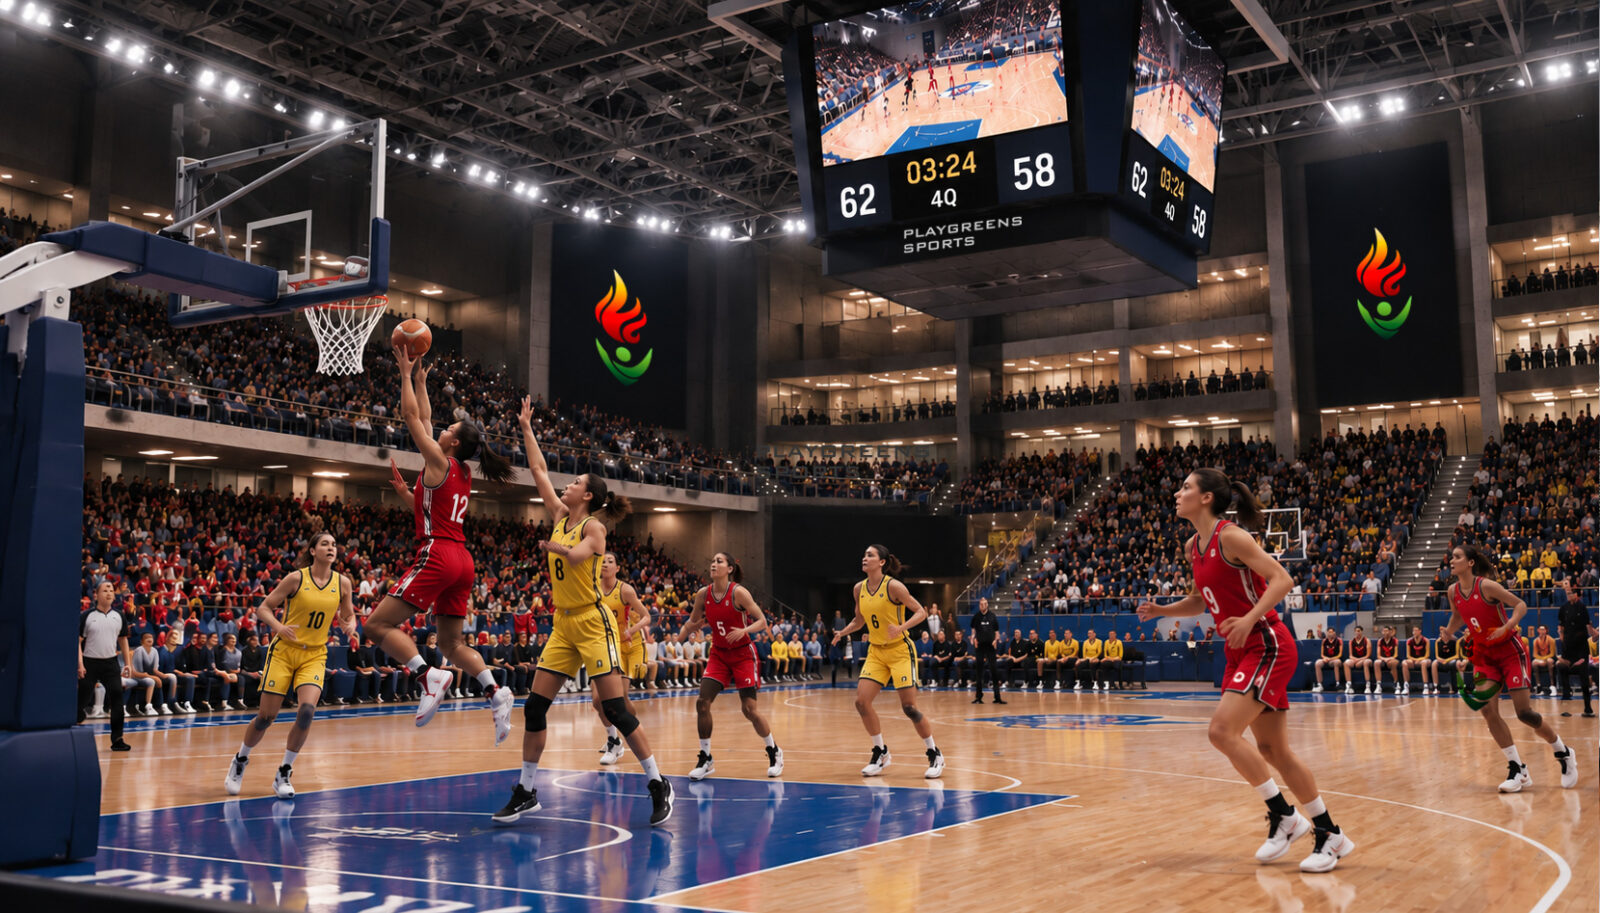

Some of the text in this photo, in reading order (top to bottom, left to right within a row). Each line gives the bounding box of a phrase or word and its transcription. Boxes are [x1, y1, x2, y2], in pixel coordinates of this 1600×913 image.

[906, 151, 977, 185] 03:24
[1013, 152, 1056, 191] 58
[1131, 161, 1148, 199] 62
[1160, 166, 1185, 201] 03:24
[839, 183, 877, 219] 62
[930, 188, 957, 208] 4Q
[1164, 201, 1175, 222] 4Q
[1192, 204, 1207, 239] 58
[903, 216, 1023, 239] PLAYGREENS
[903, 236, 975, 254] SPORTS
[450, 493, 469, 524] 12
[554, 557, 565, 581] 8
[1202, 586, 1220, 615] 9
[307, 610, 325, 630] 10
[716, 621, 727, 637] 5
[871, 614, 880, 630] 6
